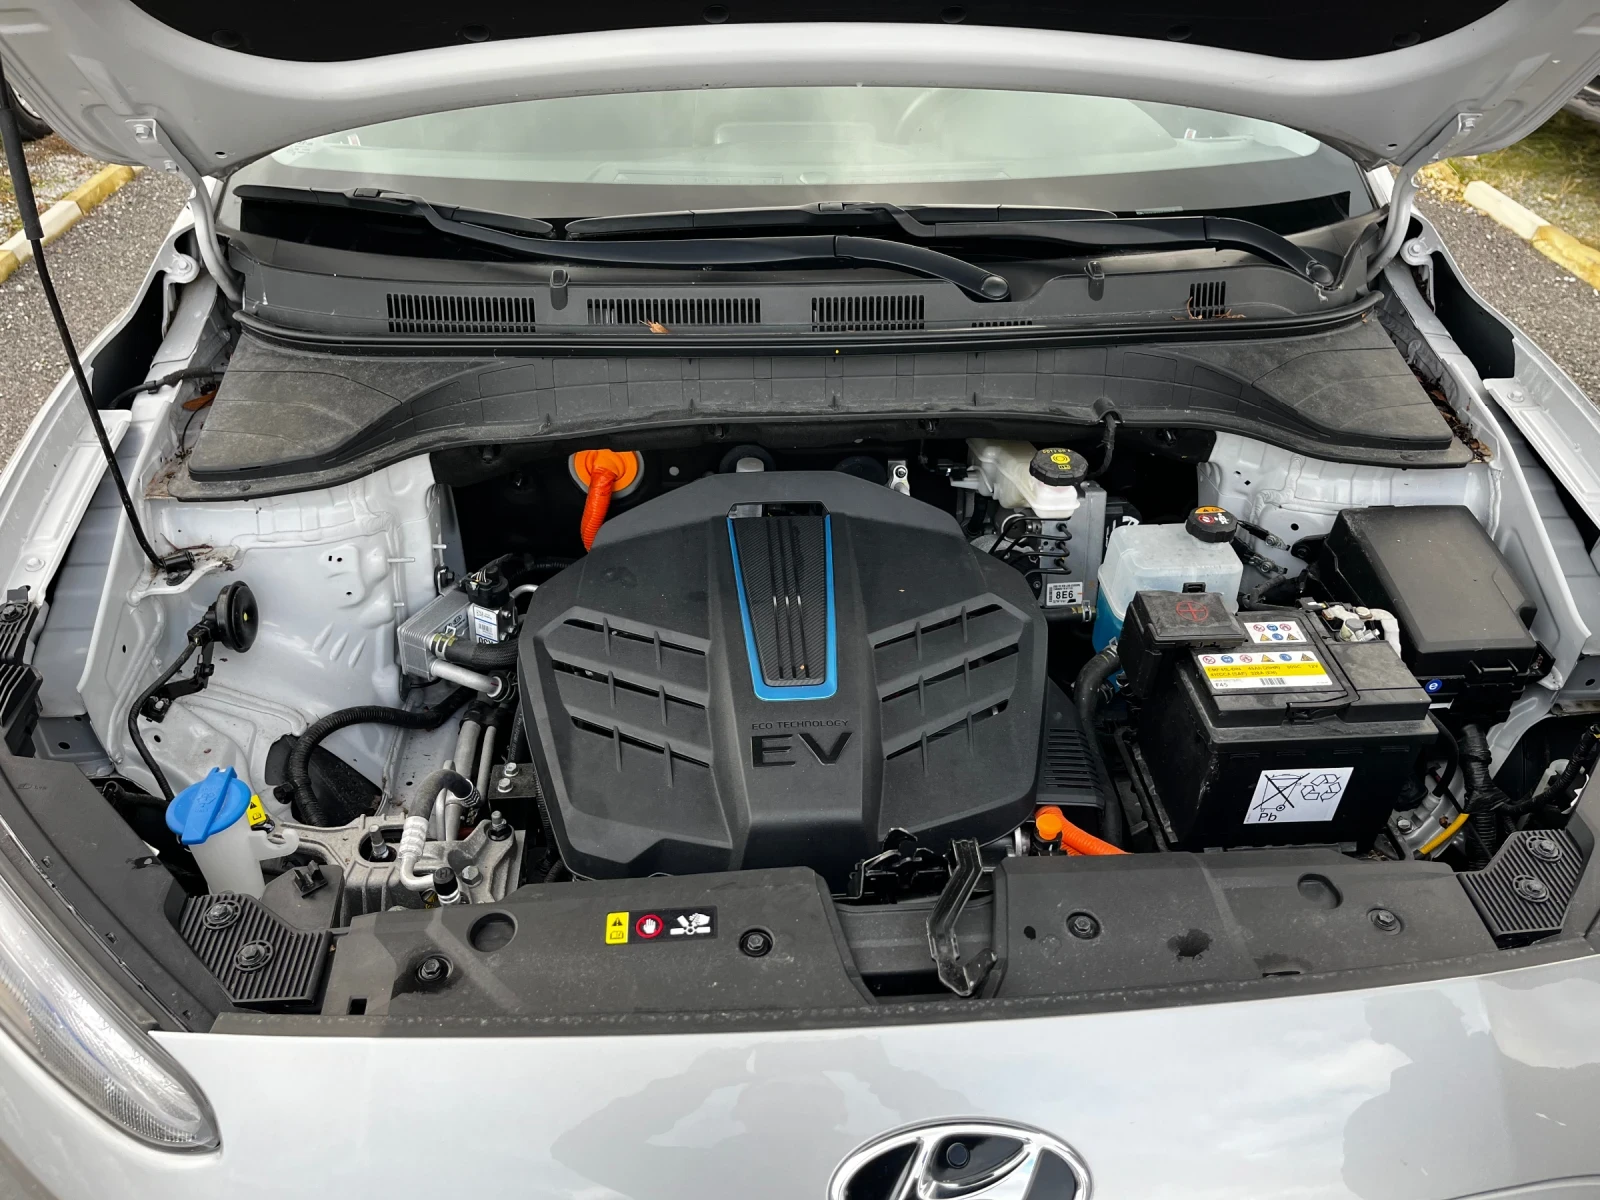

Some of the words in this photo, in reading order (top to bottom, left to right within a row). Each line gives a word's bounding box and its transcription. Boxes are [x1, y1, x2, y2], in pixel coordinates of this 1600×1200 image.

[1055, 590, 1074, 600] 8E6
[751, 722, 773, 730] ECO
[777, 720, 849, 729] TECHNOLOGY
[751, 732, 853, 769] EV
[1258, 812, 1278, 822] Pb
